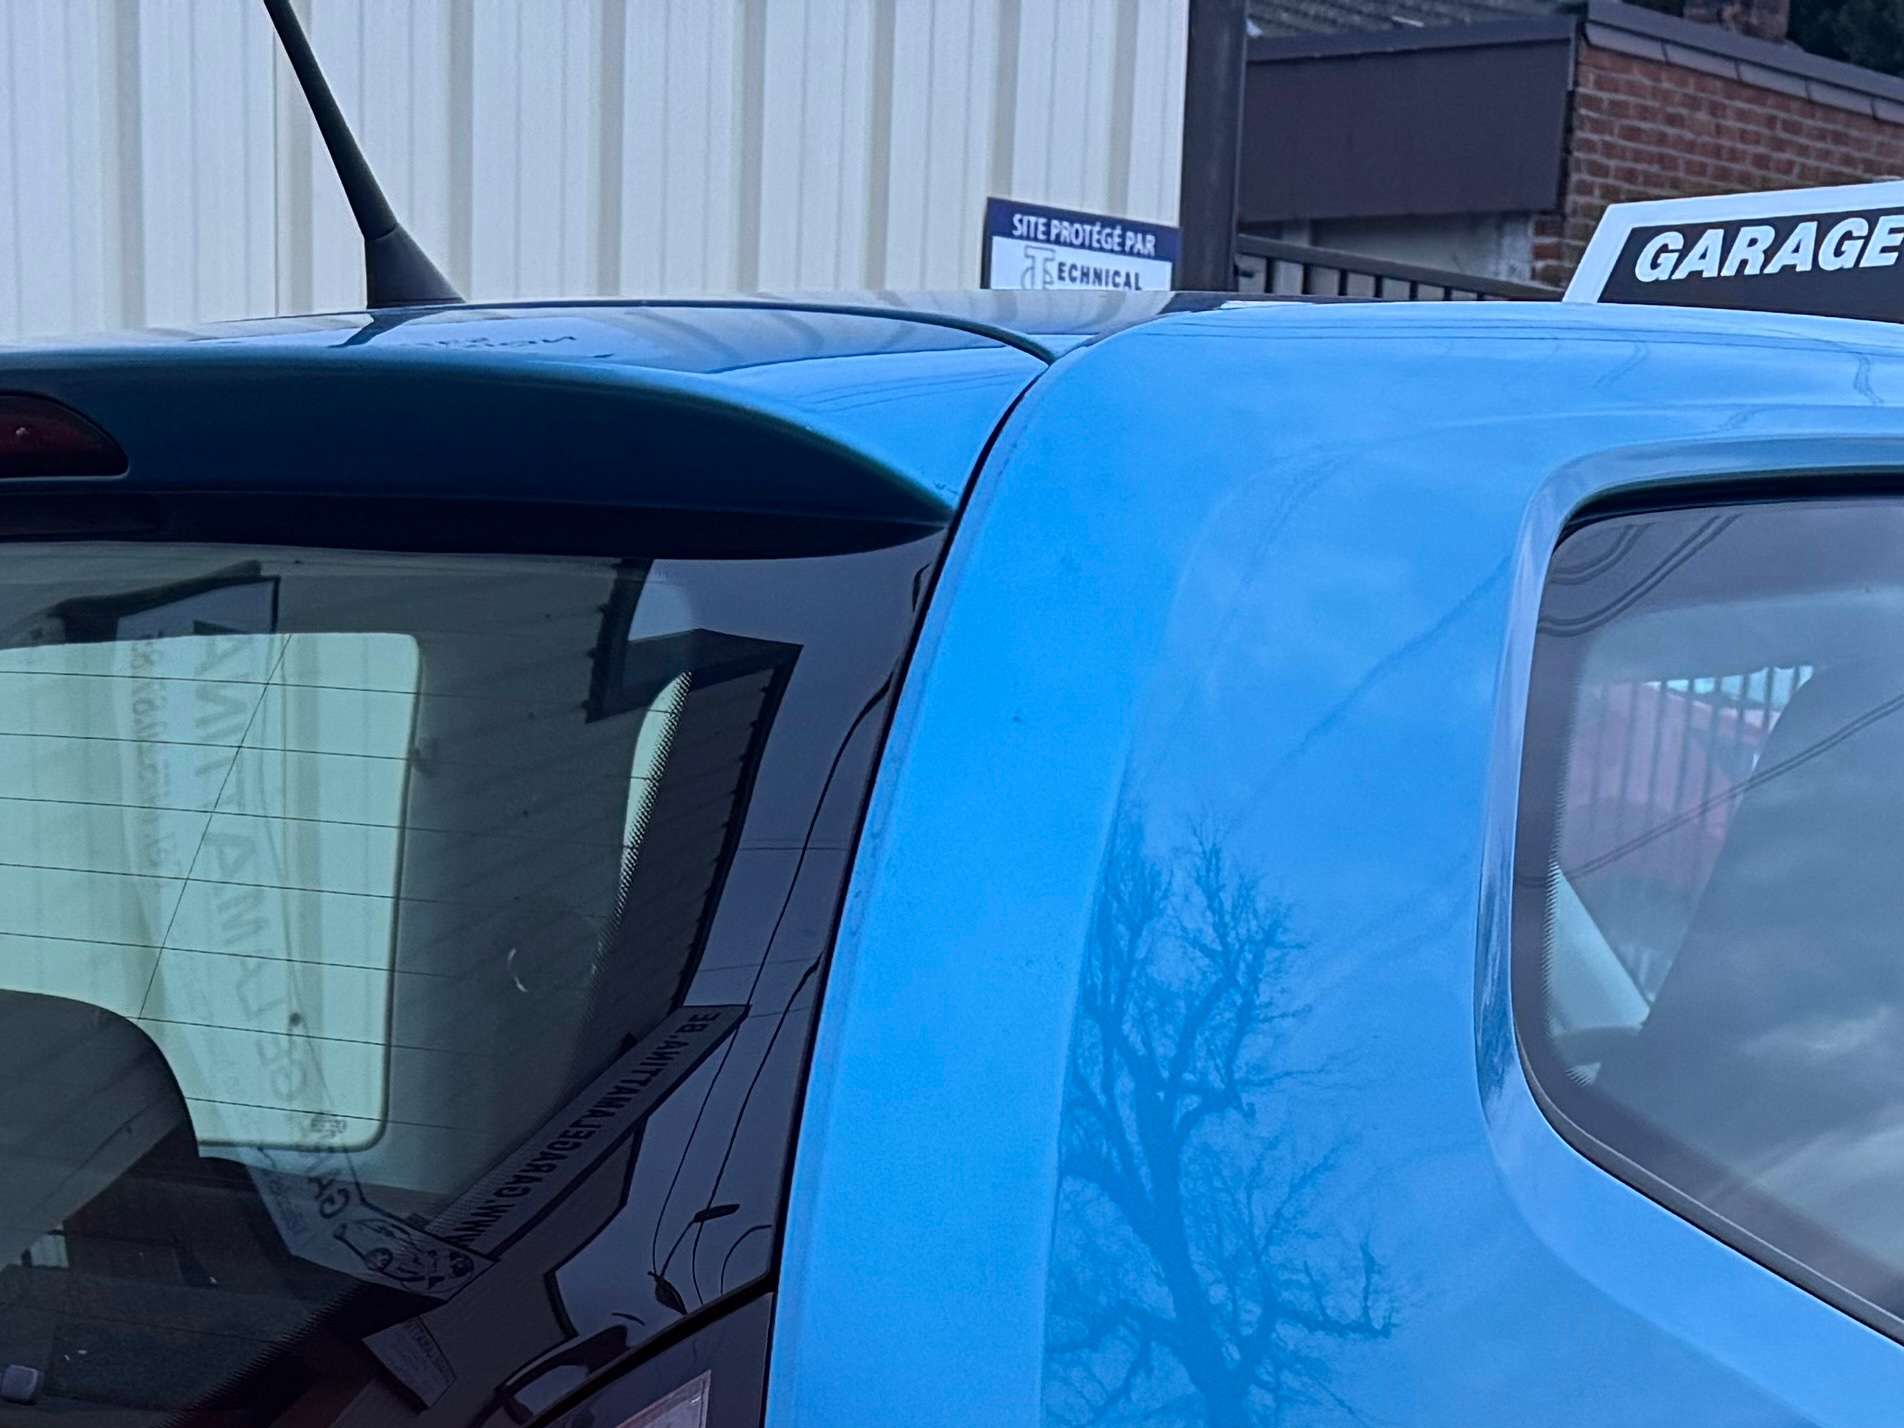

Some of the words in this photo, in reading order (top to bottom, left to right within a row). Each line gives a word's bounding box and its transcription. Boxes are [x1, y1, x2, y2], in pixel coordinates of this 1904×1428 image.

[1012, 213, 1047, 240] SITE
[1049, 219, 1123, 253] PROTÉGÉ
[1125, 229, 1157, 257] PAR
